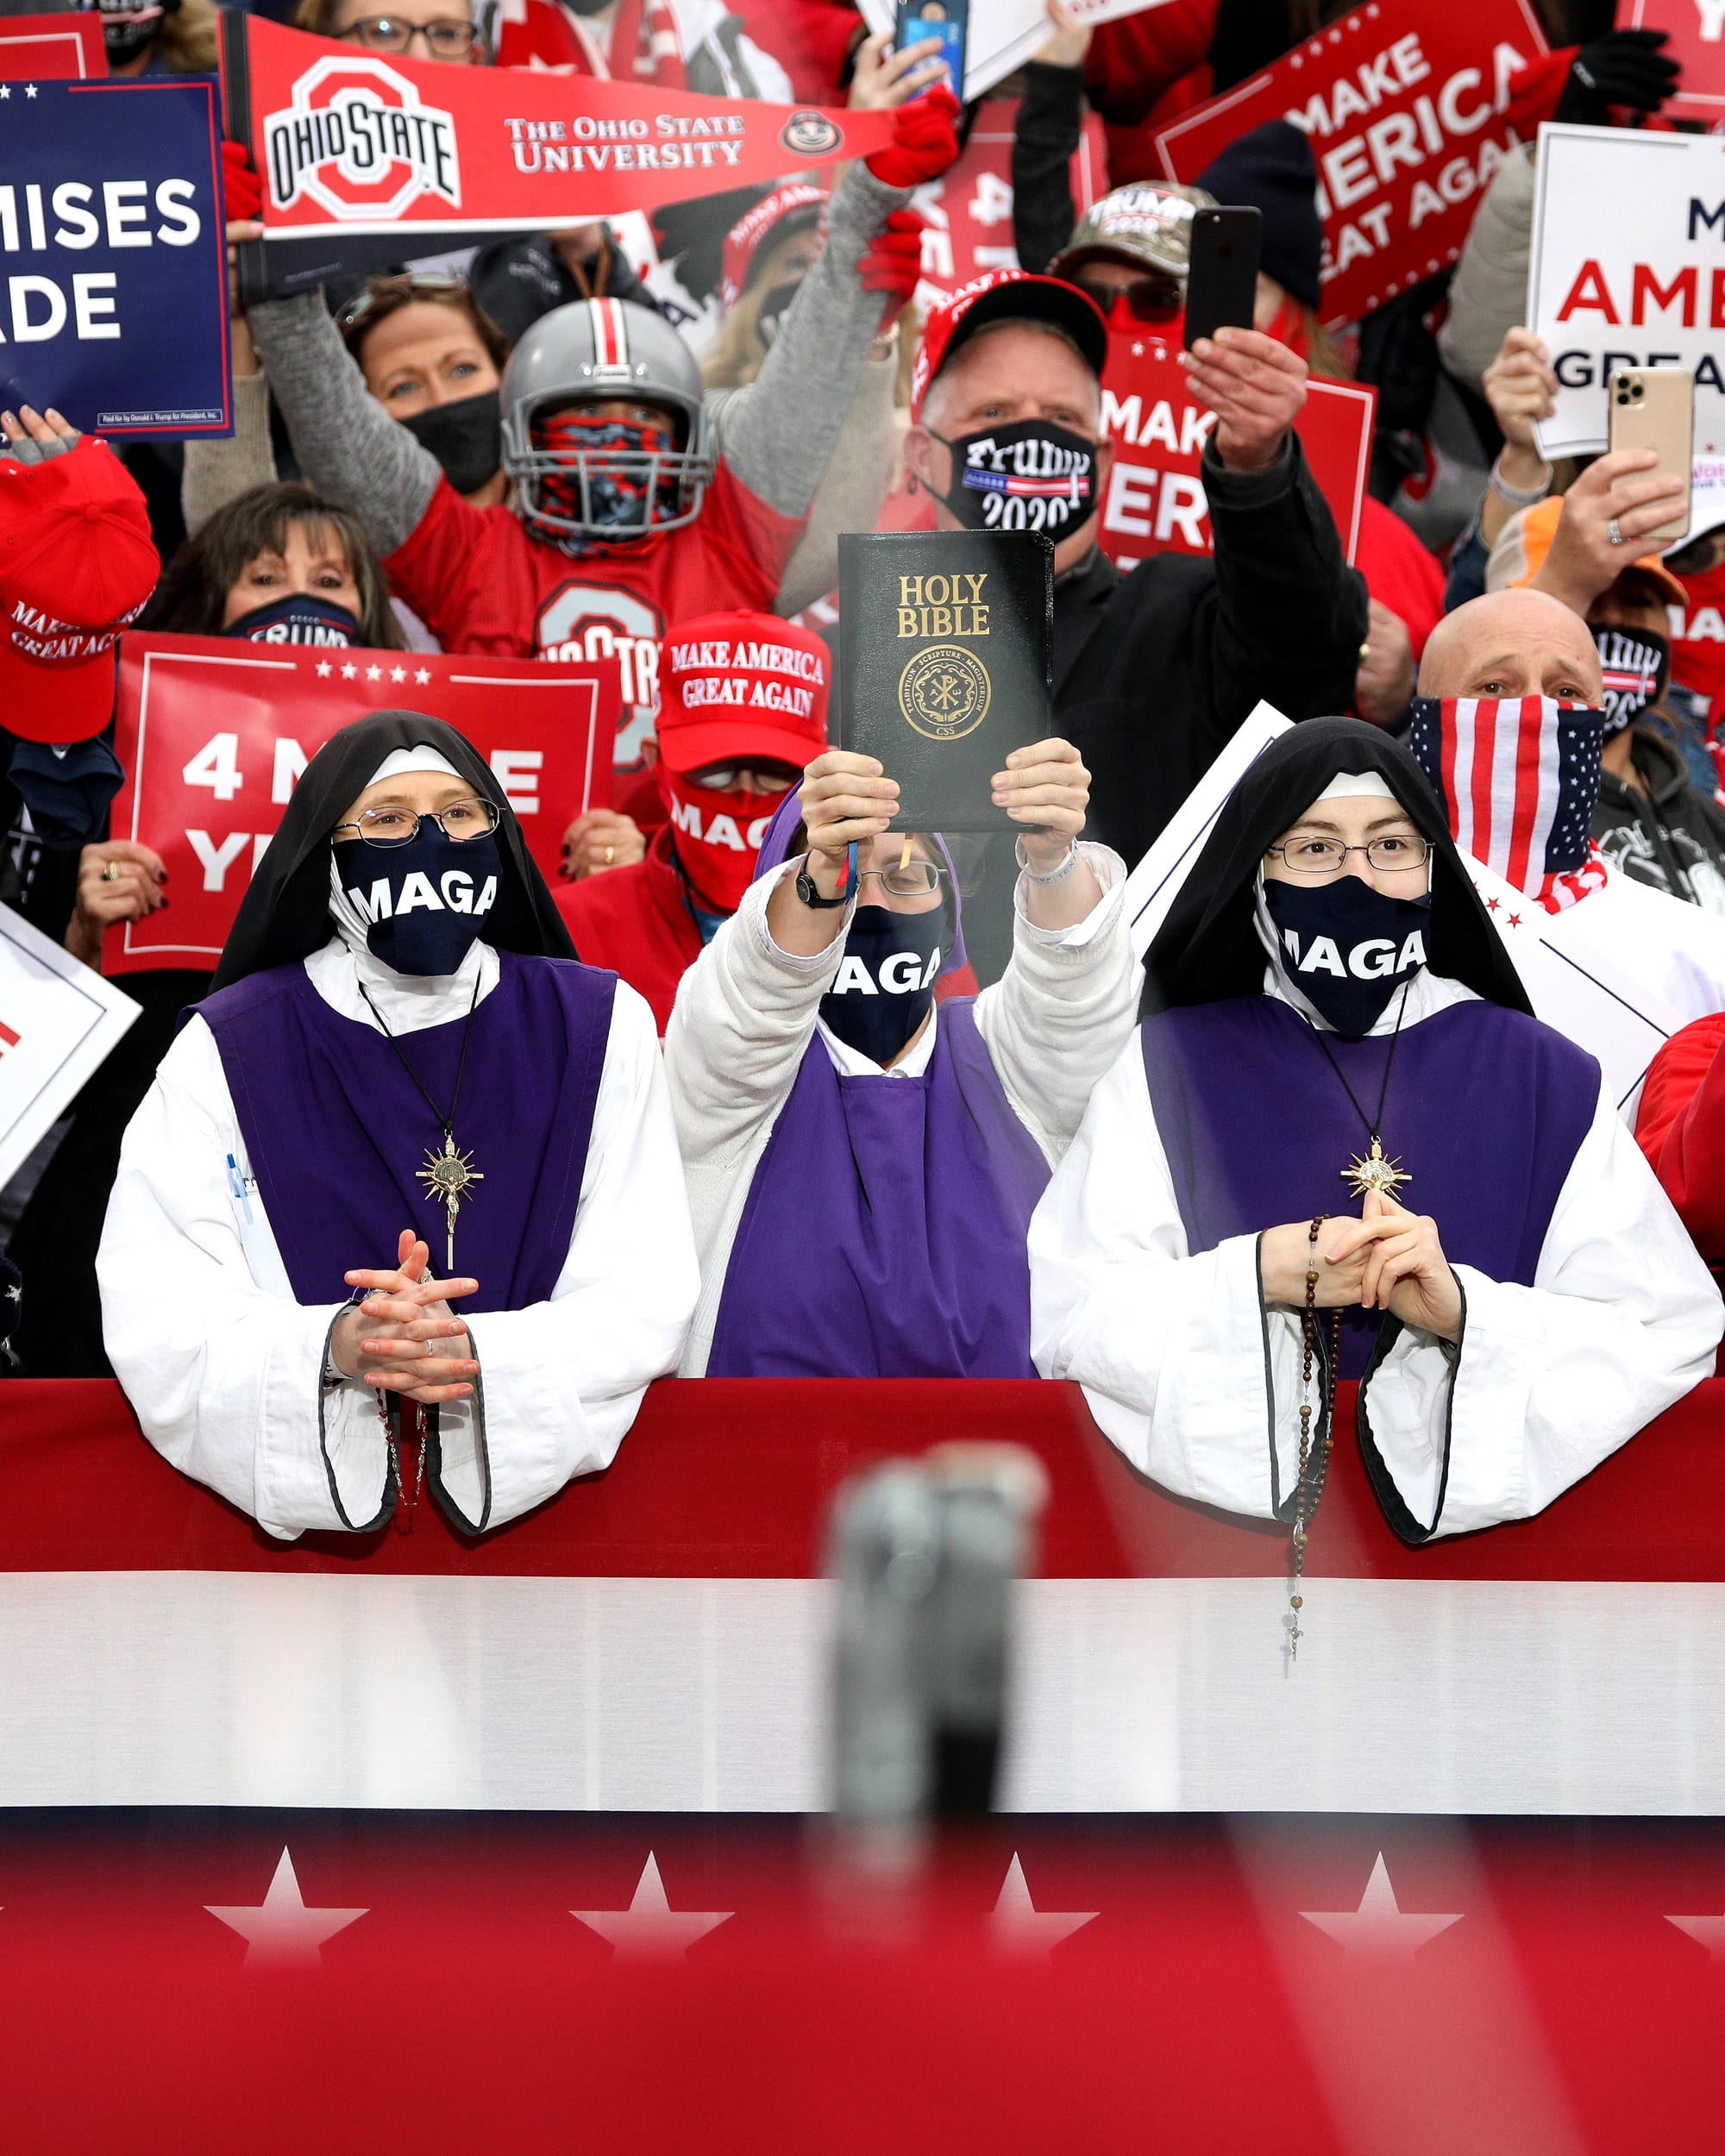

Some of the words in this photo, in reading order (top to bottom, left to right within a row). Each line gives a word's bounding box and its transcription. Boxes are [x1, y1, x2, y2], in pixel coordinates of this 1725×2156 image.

[0, 178, 202, 253] ISES
[0, 272, 122, 344] DE
[154, 413, 172, 422] Trump
[966, 437, 1091, 510] Trump
[898, 573, 988, 605] HOLY
[897, 605, 990, 638] BIBLE
[11, 630, 84, 661] GREAT
[671, 641, 731, 674] MAKE
[731, 641, 825, 686] AMERICA
[682, 677, 749, 709] GREAT
[749, 680, 815, 718] AGAIN
[904, 667, 917, 714] TRADITION
[919, 650, 962, 666] SCRIPTURE
[965, 658, 986, 712] MAGISTERIUM
[936, 726, 956, 736] CSS
[348, 870, 498, 925] MAGA
[831, 946, 942, 995] AGA
